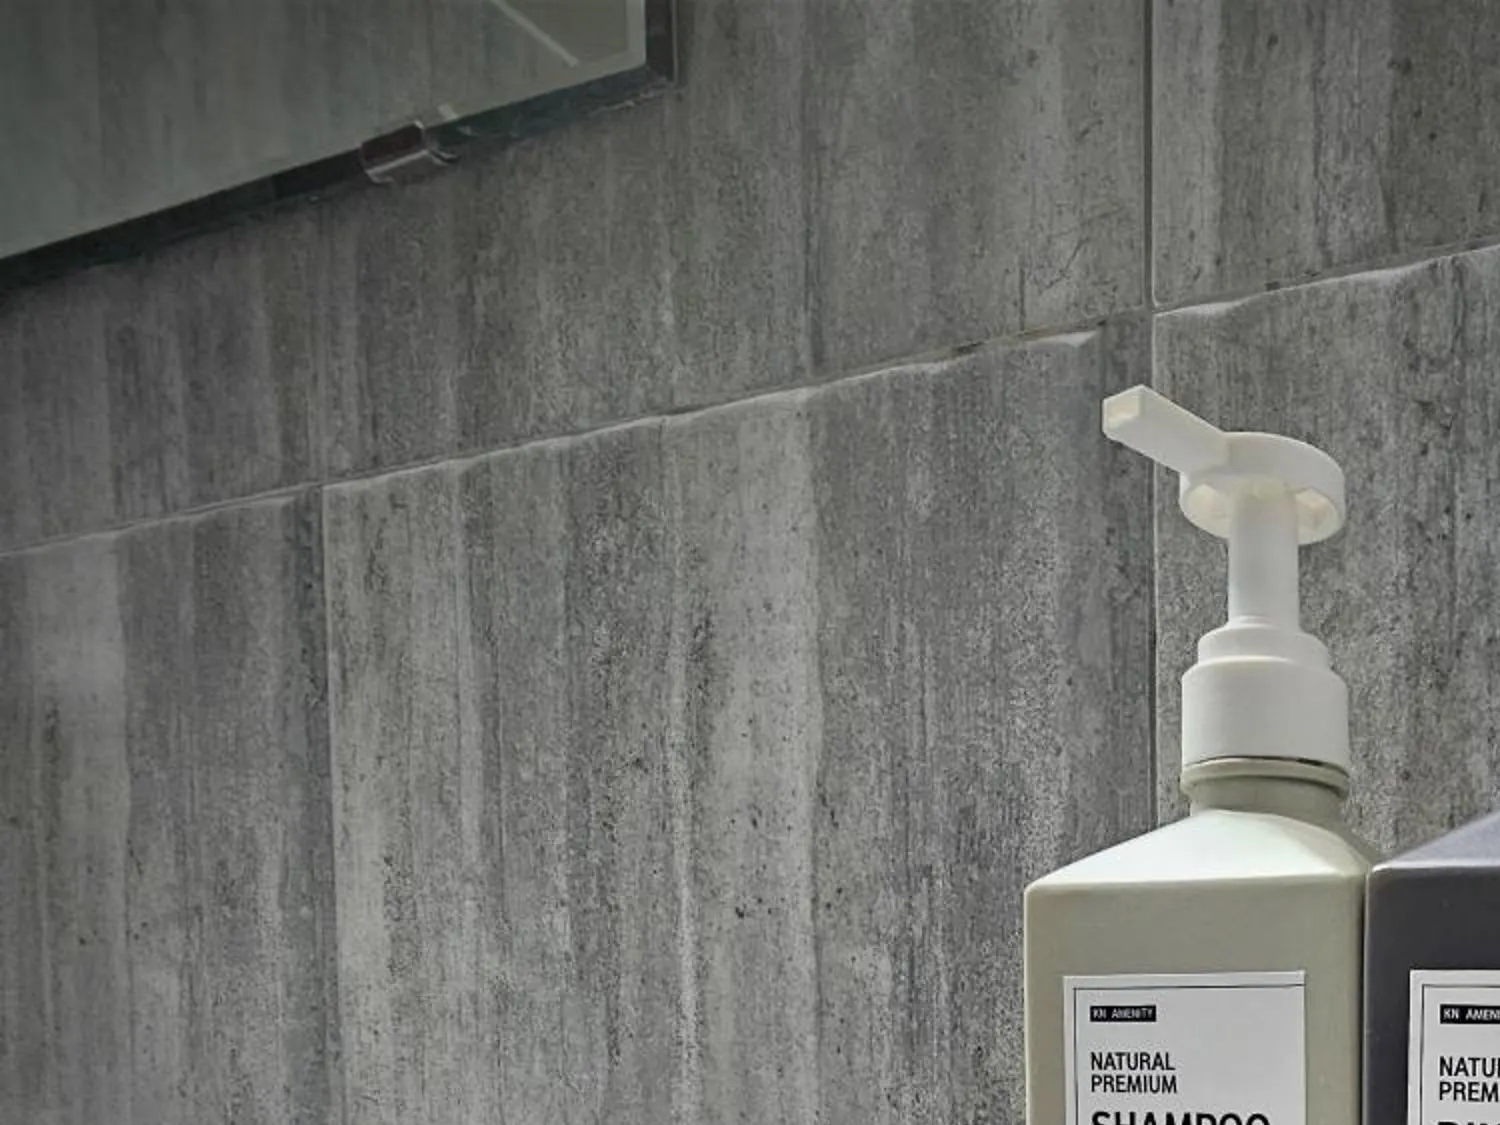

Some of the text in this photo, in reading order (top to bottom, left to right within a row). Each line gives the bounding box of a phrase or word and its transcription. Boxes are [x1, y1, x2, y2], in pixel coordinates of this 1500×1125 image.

[1111, 1008, 1153, 1019] AMENITY
[1443, 1009, 1459, 1020] KN
[1091, 1052, 1176, 1071] NATURAL
[1091, 1075, 1177, 1094] PREMIUM
